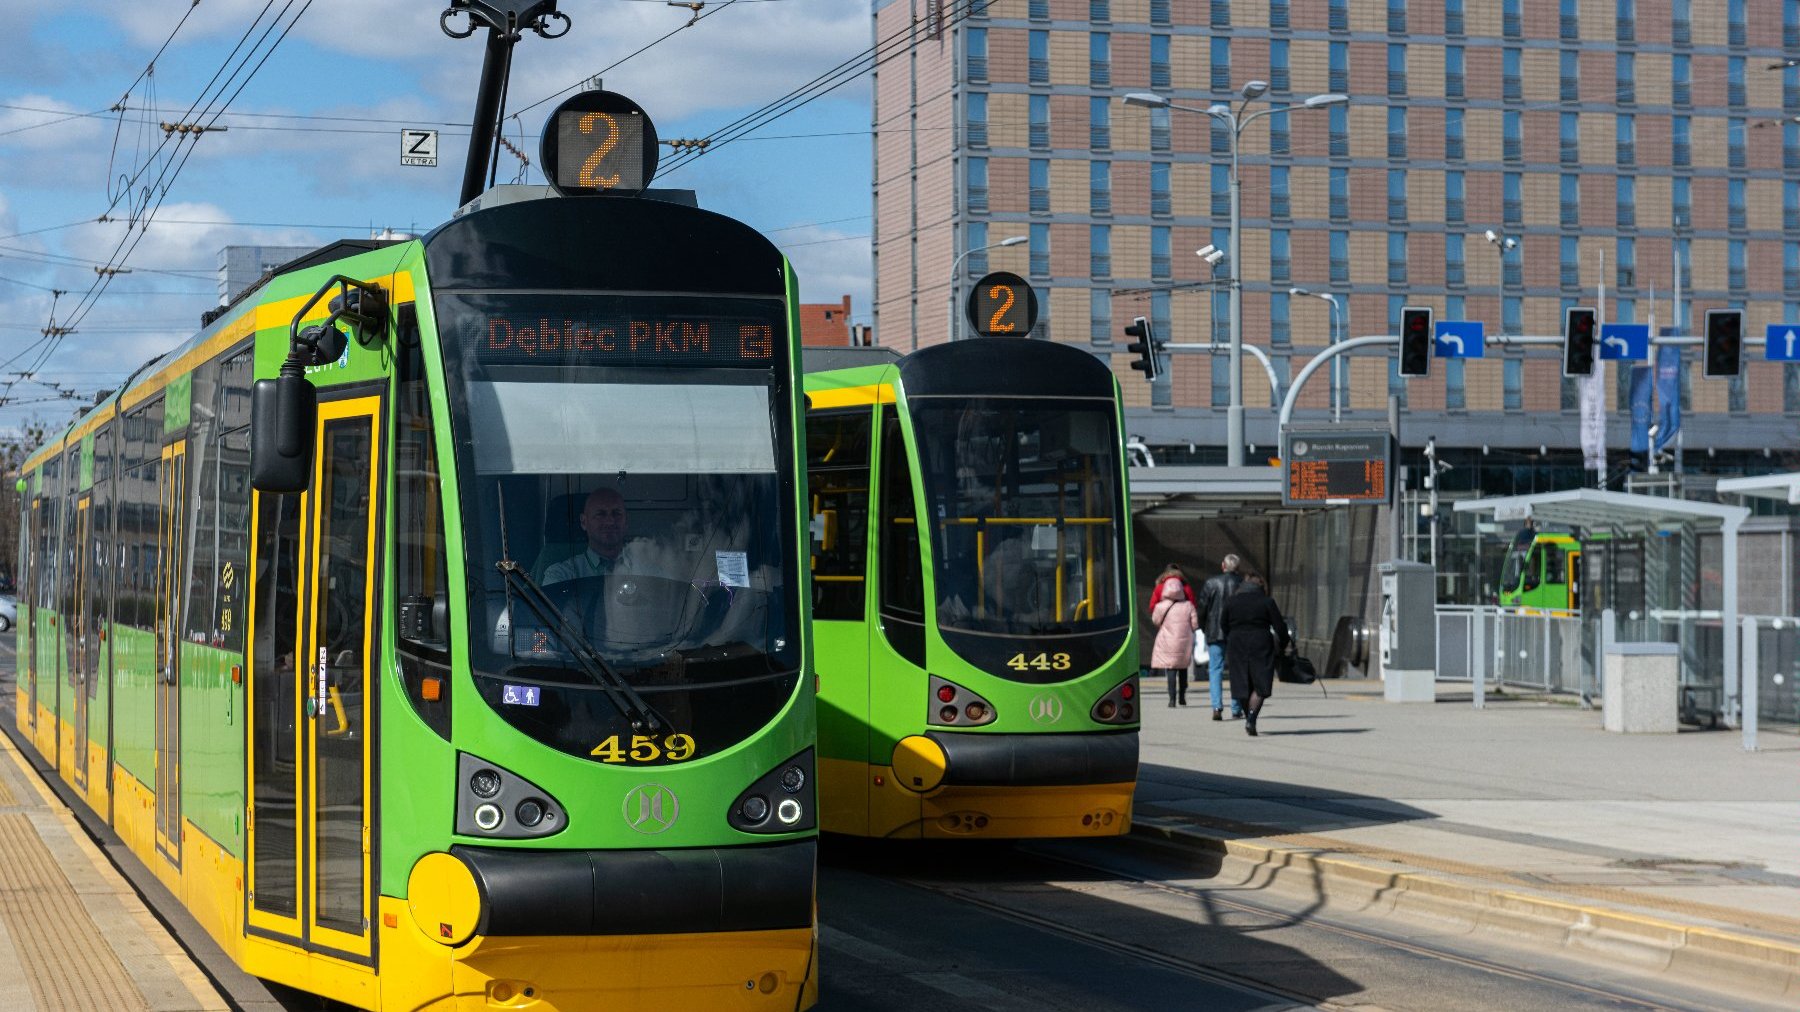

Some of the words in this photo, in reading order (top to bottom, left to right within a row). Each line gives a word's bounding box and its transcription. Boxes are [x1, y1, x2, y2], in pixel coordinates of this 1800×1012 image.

[929, 0, 937, 34] Mercu
[408, 132, 430, 154] Z
[579, 112, 619, 188] 2
[989, 285, 1015, 332] 2
[489, 318, 615, 357] Dębiec
[629, 321, 710, 352] PKM
[533, 632, 547, 653] 2
[1006, 652, 1071, 671] 443
[590, 733, 696, 763] 459
